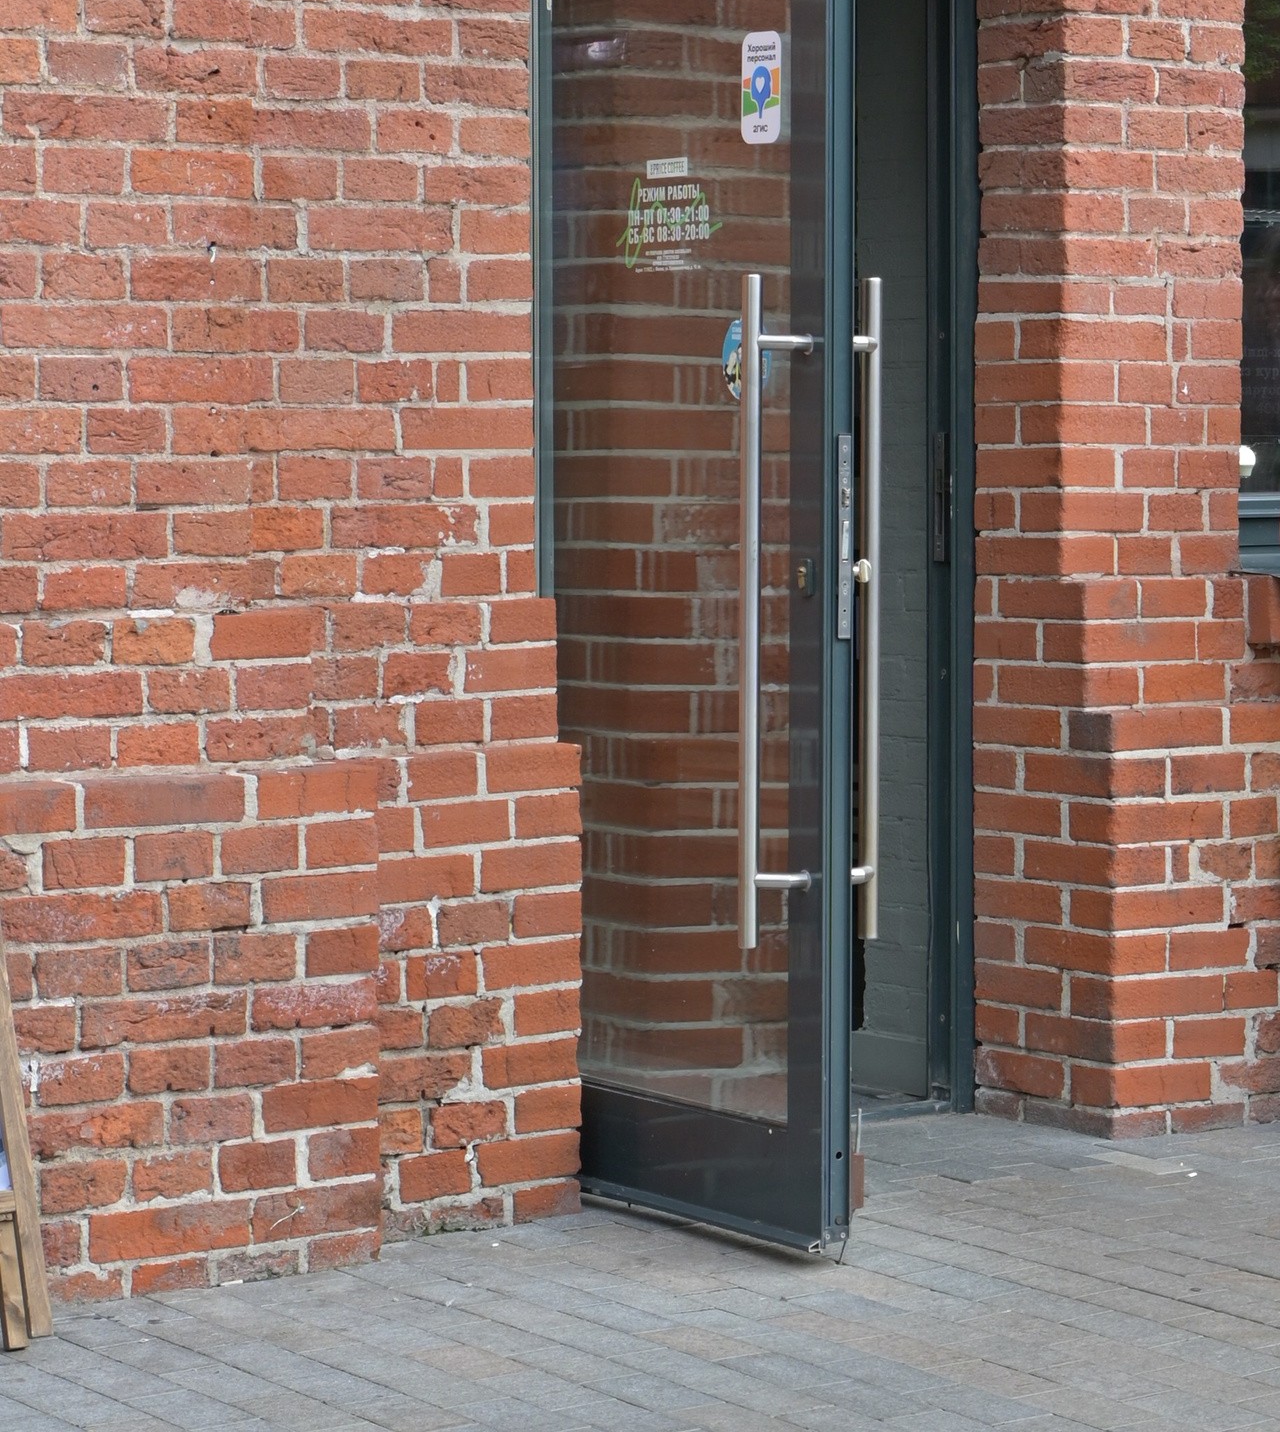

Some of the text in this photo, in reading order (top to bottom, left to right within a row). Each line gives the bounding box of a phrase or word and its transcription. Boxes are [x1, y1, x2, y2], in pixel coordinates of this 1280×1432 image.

[747, 42, 776, 55] Хороший
[747, 53, 776, 64] персонал
[753, 124, 768, 133] 2ГИС
[638, 184, 700, 203] РЕЖИМ РАБОТЫ
[628, 204, 709, 226] ПН-ПТ 07:30-21:00
[628, 223, 710, 244] СБ-ВС 08:30-20:00
